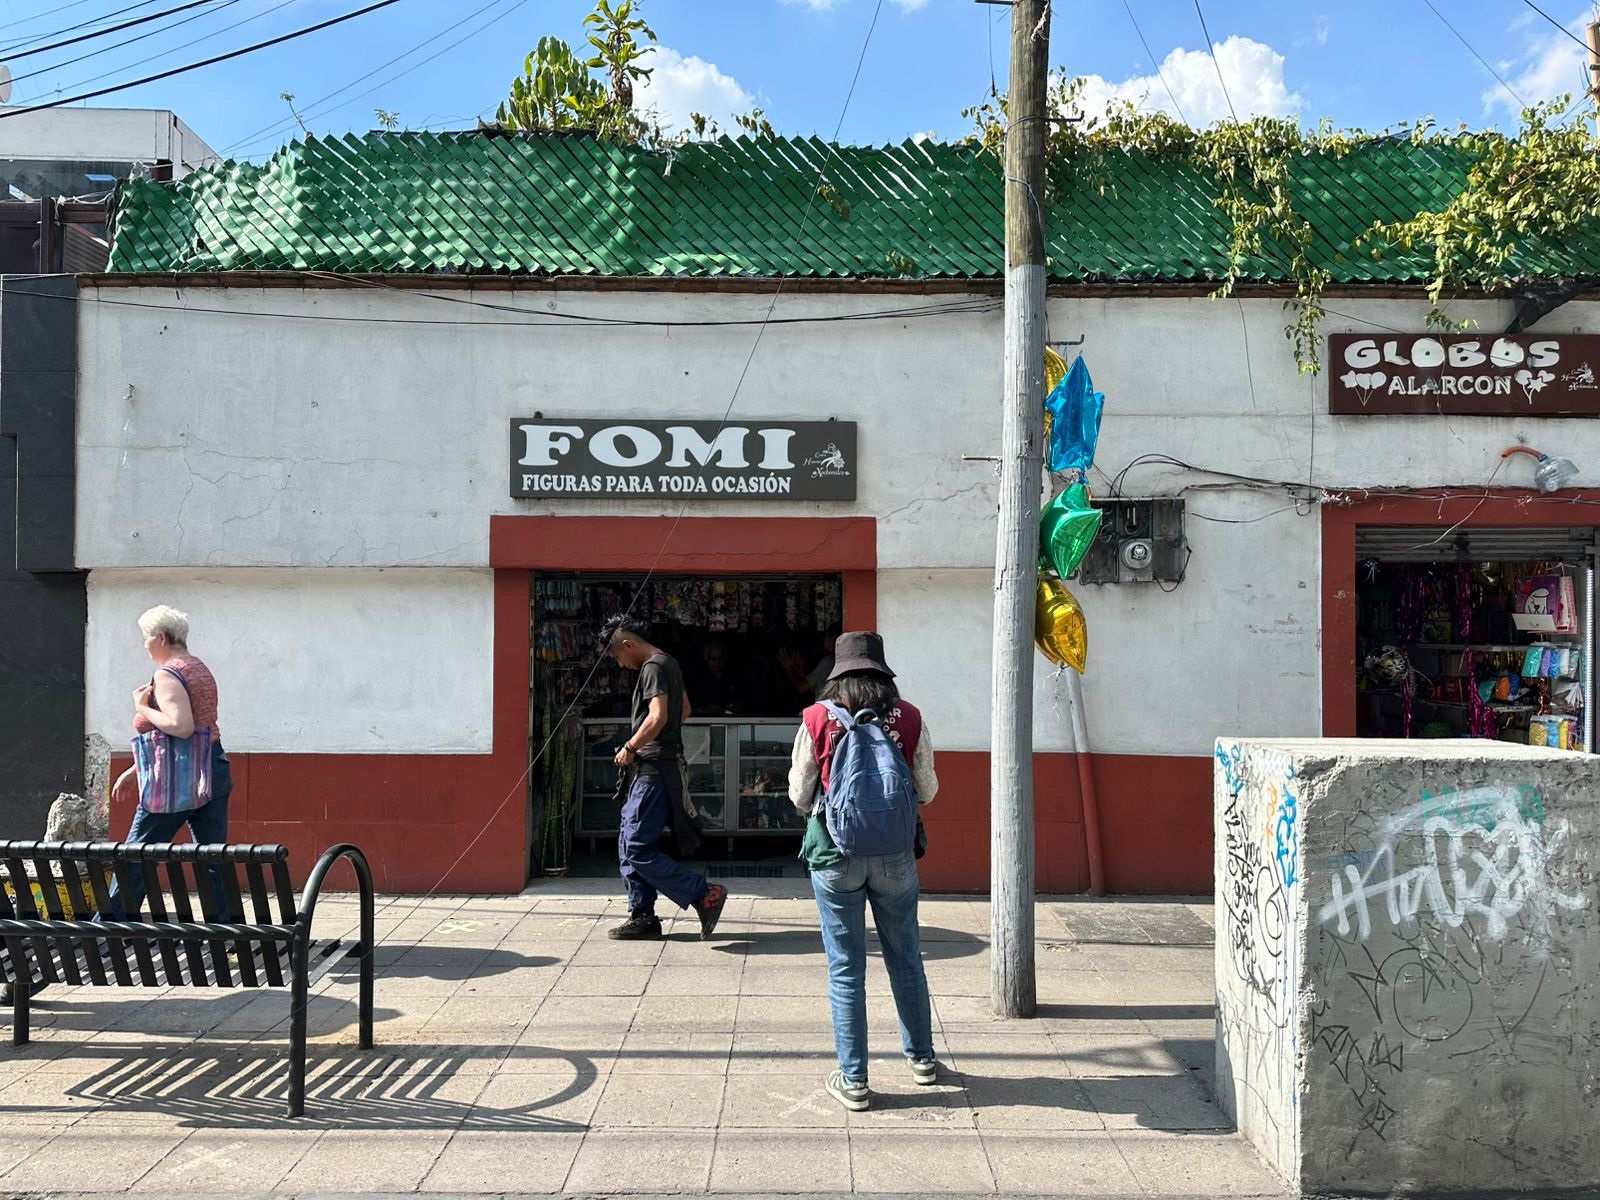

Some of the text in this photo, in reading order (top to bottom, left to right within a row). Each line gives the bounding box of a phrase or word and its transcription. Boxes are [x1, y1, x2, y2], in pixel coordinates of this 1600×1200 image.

[1344, 337, 1560, 368] GLOBOS
[1387, 374, 1512, 396] ALARCON
[518, 424, 796, 469] FOMI
[522, 472, 791, 493] FIGURAS PARA TODA OCASIÓN
